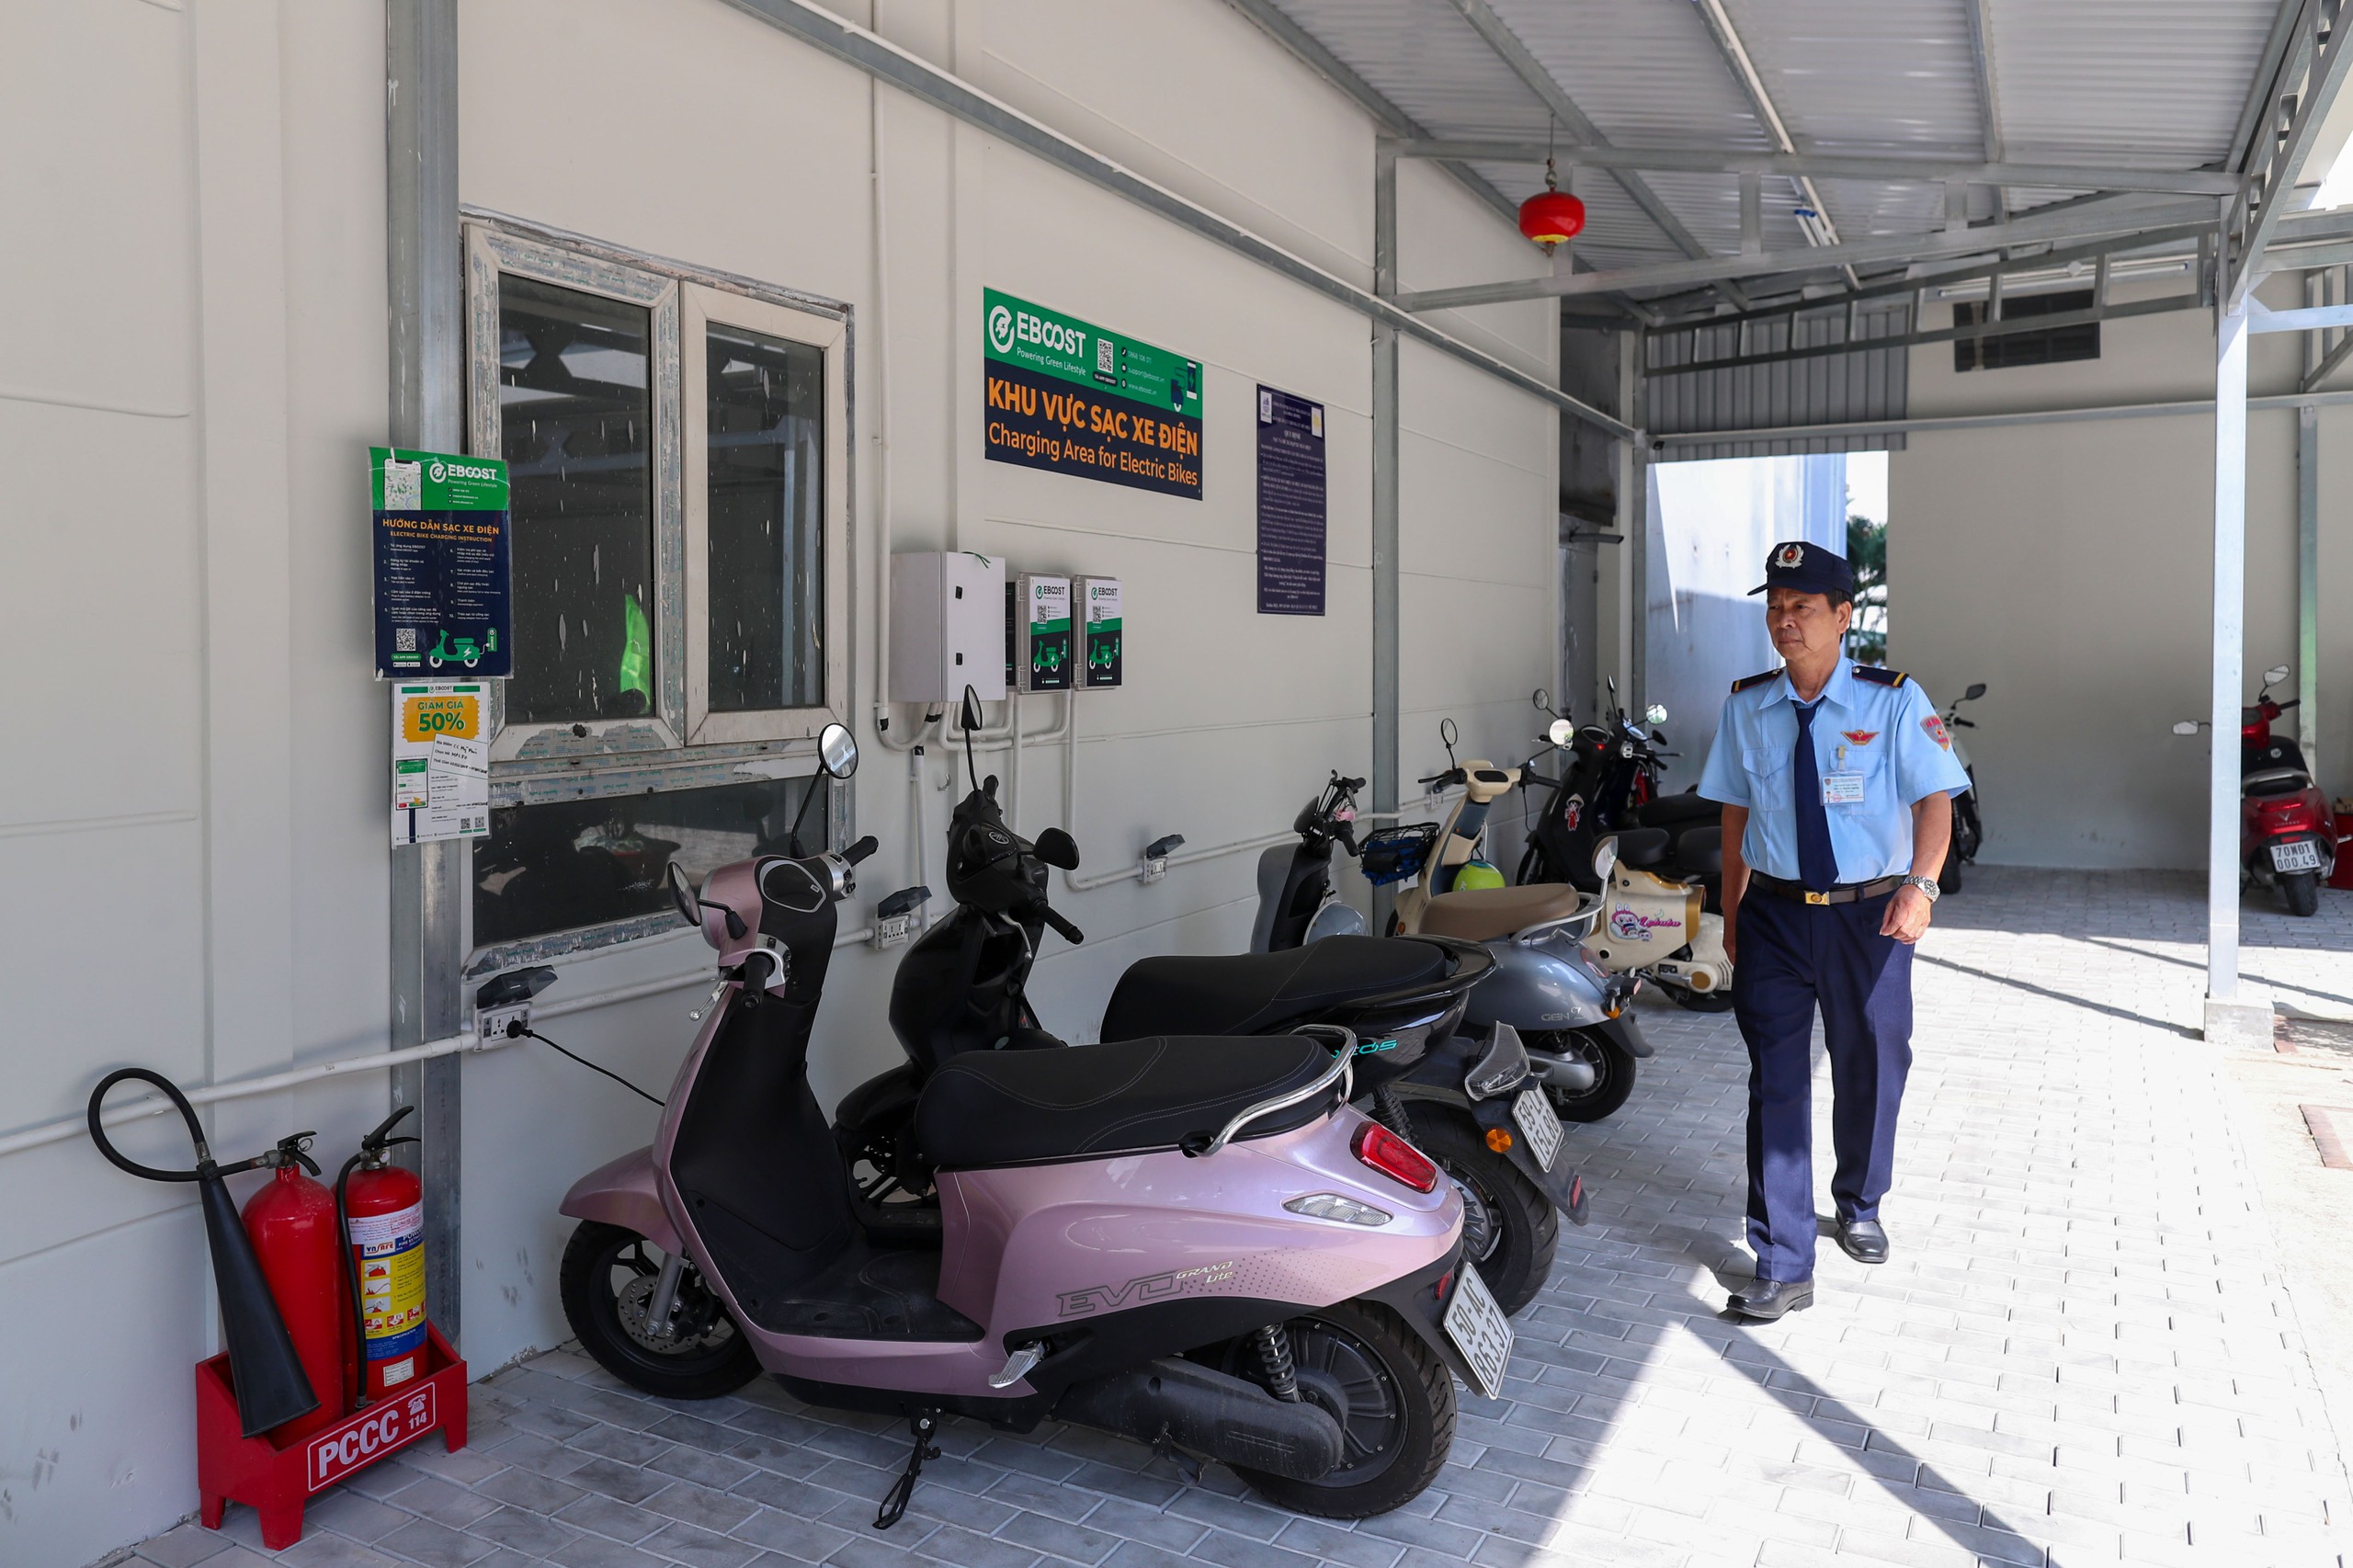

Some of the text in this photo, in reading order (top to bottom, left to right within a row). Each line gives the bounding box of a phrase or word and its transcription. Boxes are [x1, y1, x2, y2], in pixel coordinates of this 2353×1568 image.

[1017, 311, 1086, 358] EBOOST
[1017, 347, 1086, 375] Powering Green Lifestyle
[989, 377, 1197, 460] KHU VỰC SẠC XE ĐIỆN
[989, 422, 1197, 485] Charging Area for Electric Bikes
[448, 464, 496, 480] EBOOST
[383, 518, 499, 536] HƯỚNG DẪN SẠC XE ĐIỆN
[1043, 586, 1065, 596] EBOOST
[1098, 587, 1118, 596] EBOOST
[418, 699, 463, 710] GIẢM GIÁ
[419, 712, 465, 732] 50%
[2277, 855, 2316, 869] 000.49
[1540, 1013, 1570, 1021] GEN
[1533, 1108, 1559, 1162] 154.88
[1176, 1261, 1233, 1279] GRAND
[1206, 1271, 1233, 1283] Lite
[1056, 1270, 1184, 1317] EVO
[1452, 1278, 1485, 1346] 50-AC
[1474, 1305, 1507, 1385] 863.37
[409, 1412, 426, 1430] 114
[319, 1410, 399, 1479] PCCC
